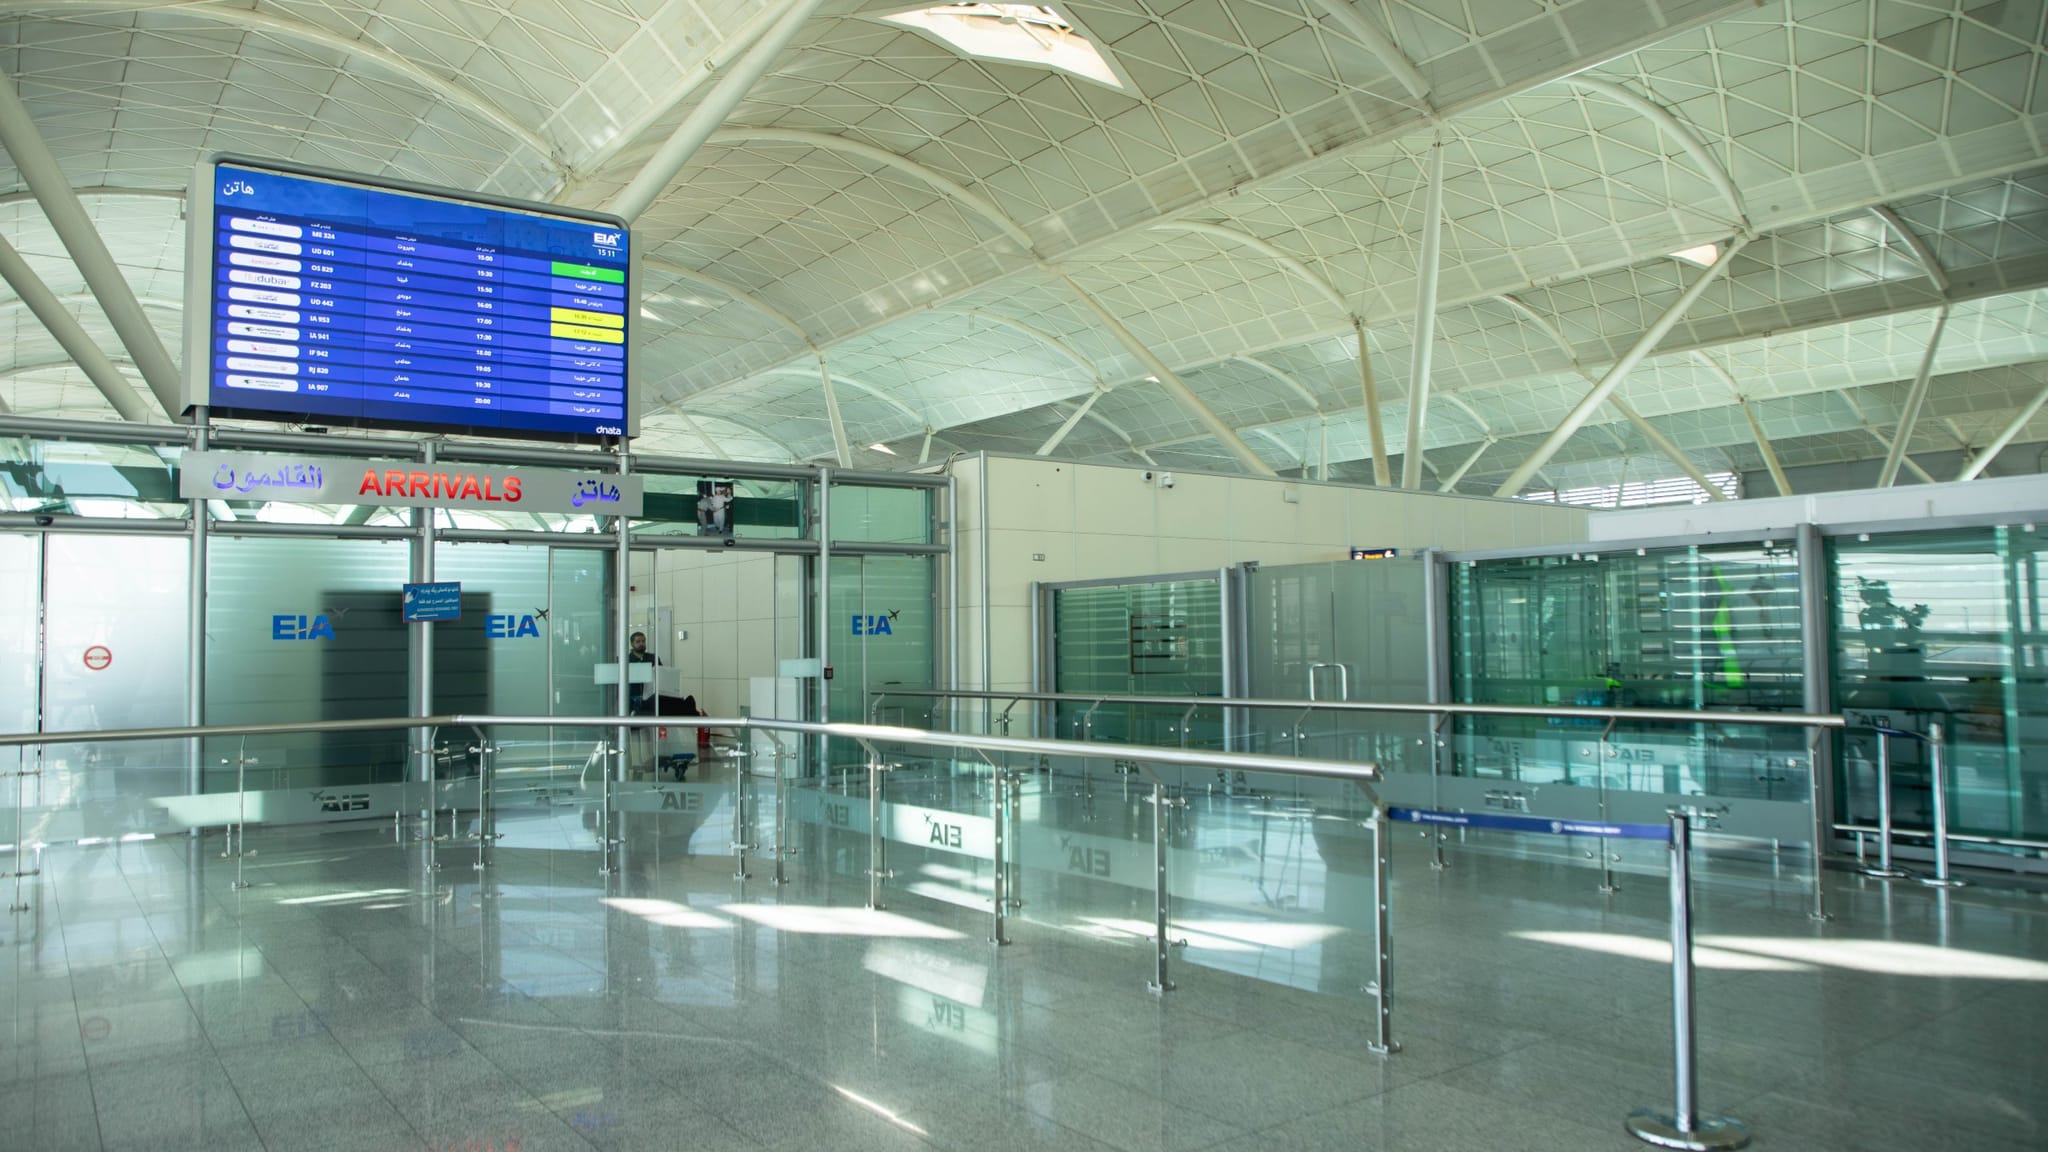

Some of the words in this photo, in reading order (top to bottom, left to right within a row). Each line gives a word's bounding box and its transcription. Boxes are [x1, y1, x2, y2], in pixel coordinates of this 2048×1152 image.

[223, 181, 255, 196] هاتن
[593, 232, 617, 247] EIA
[596, 425, 622, 435] dnata
[213, 463, 323, 493] القادمون
[359, 469, 523, 502] ARRIVALS
[572, 479, 621, 507] هاتن
[272, 615, 336, 640] EIA
[485, 615, 539, 638] EIA
[851, 615, 893, 636] EIA
